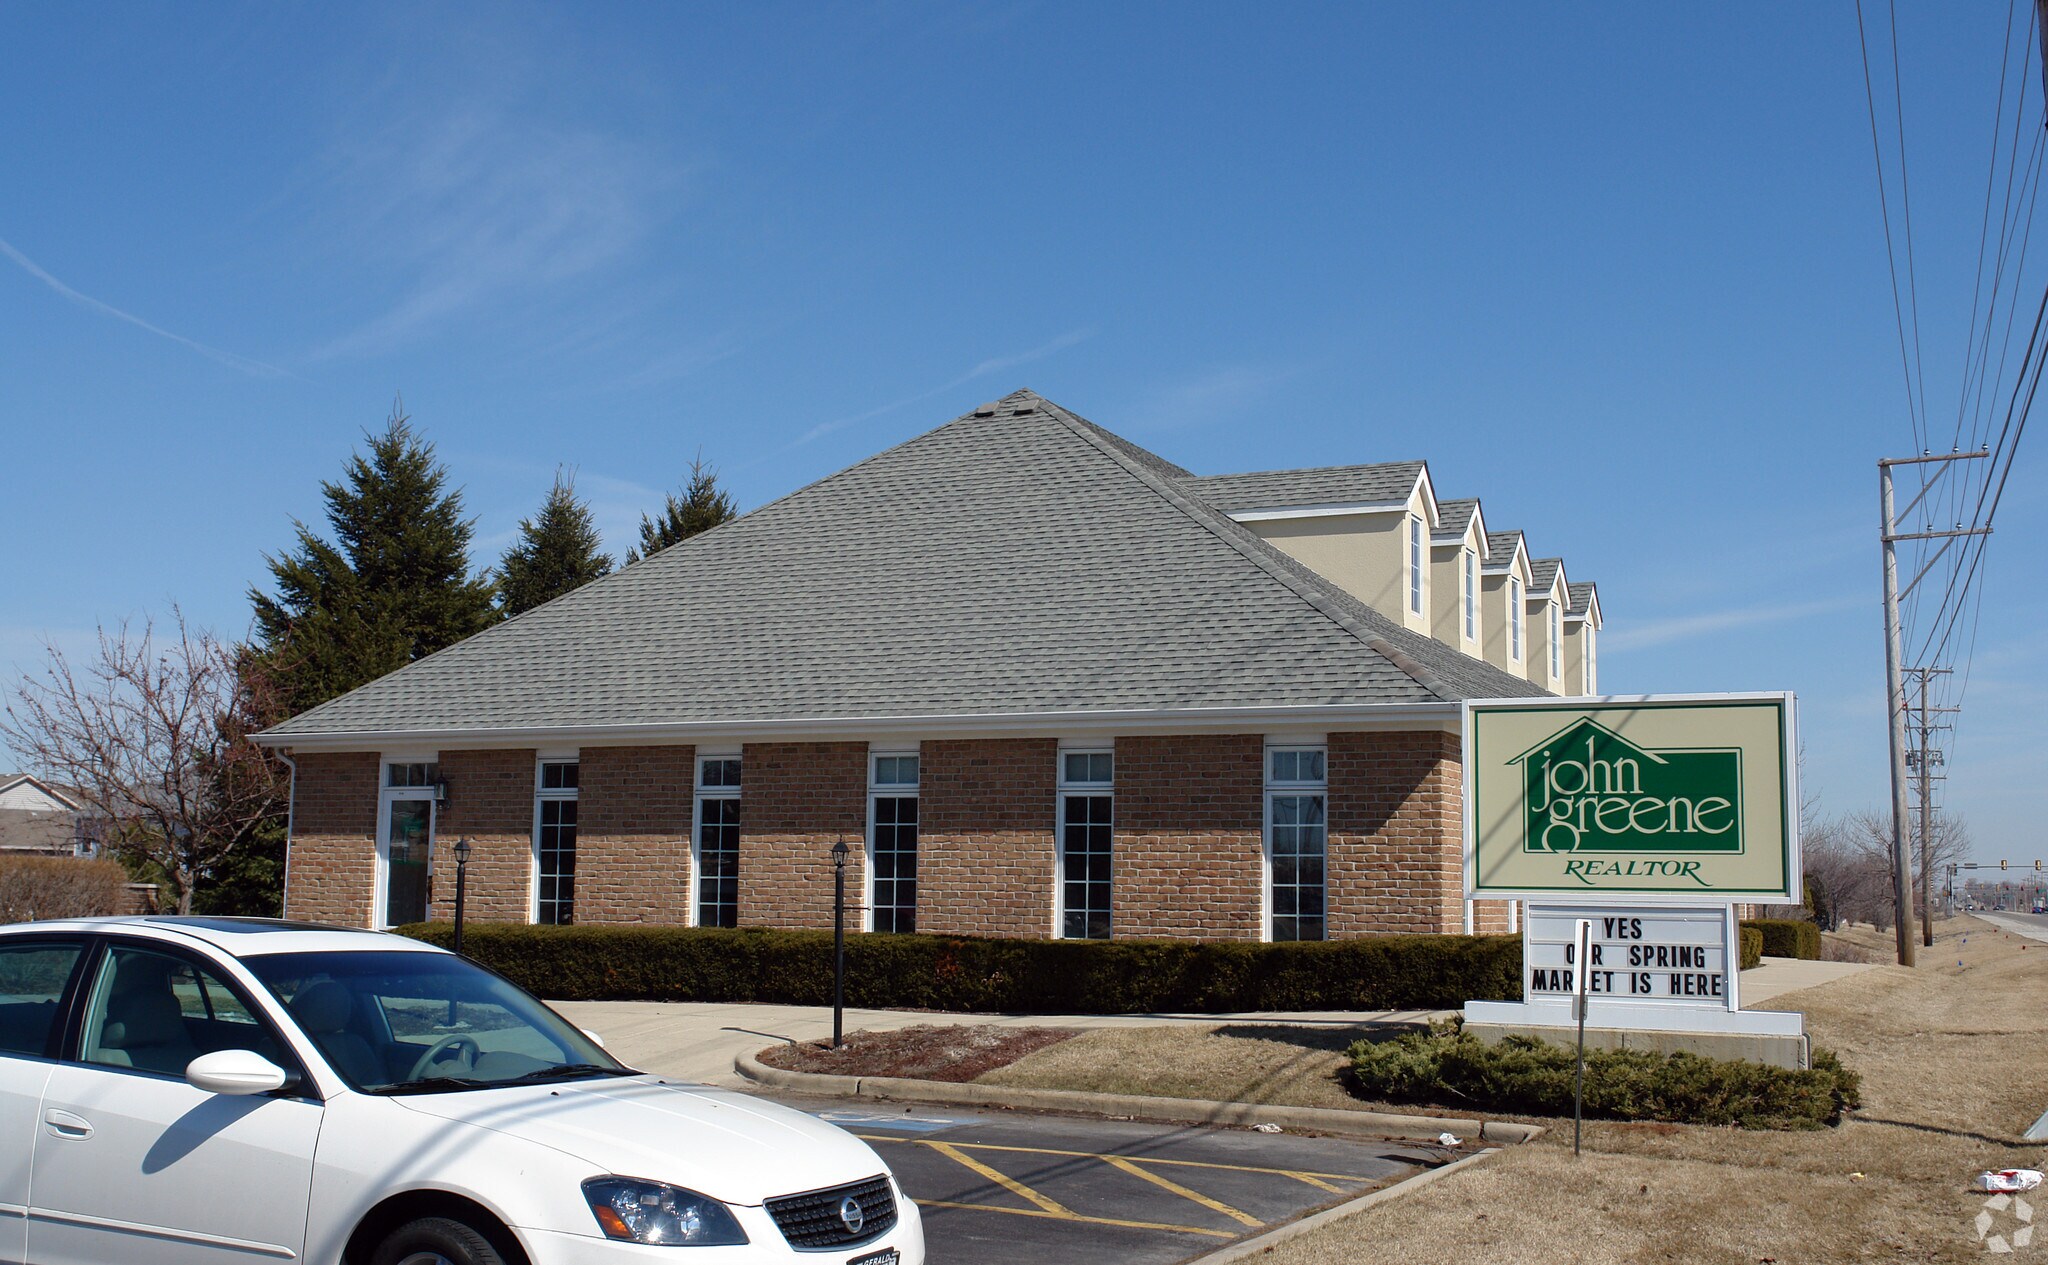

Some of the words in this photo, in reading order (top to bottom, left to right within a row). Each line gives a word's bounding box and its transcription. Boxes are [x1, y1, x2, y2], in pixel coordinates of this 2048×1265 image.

[1531, 735, 1644, 812] john
[1541, 795, 1735, 854] greene
[1563, 859, 1714, 887] REALTOR
[1603, 917, 1642, 939] YES
[1566, 943, 1603, 966] OR
[1629, 944, 1705, 968] SPRING
[1532, 969, 1615, 993] MARET
[1631, 972, 1652, 994] IS
[1670, 973, 1722, 996] HERE
